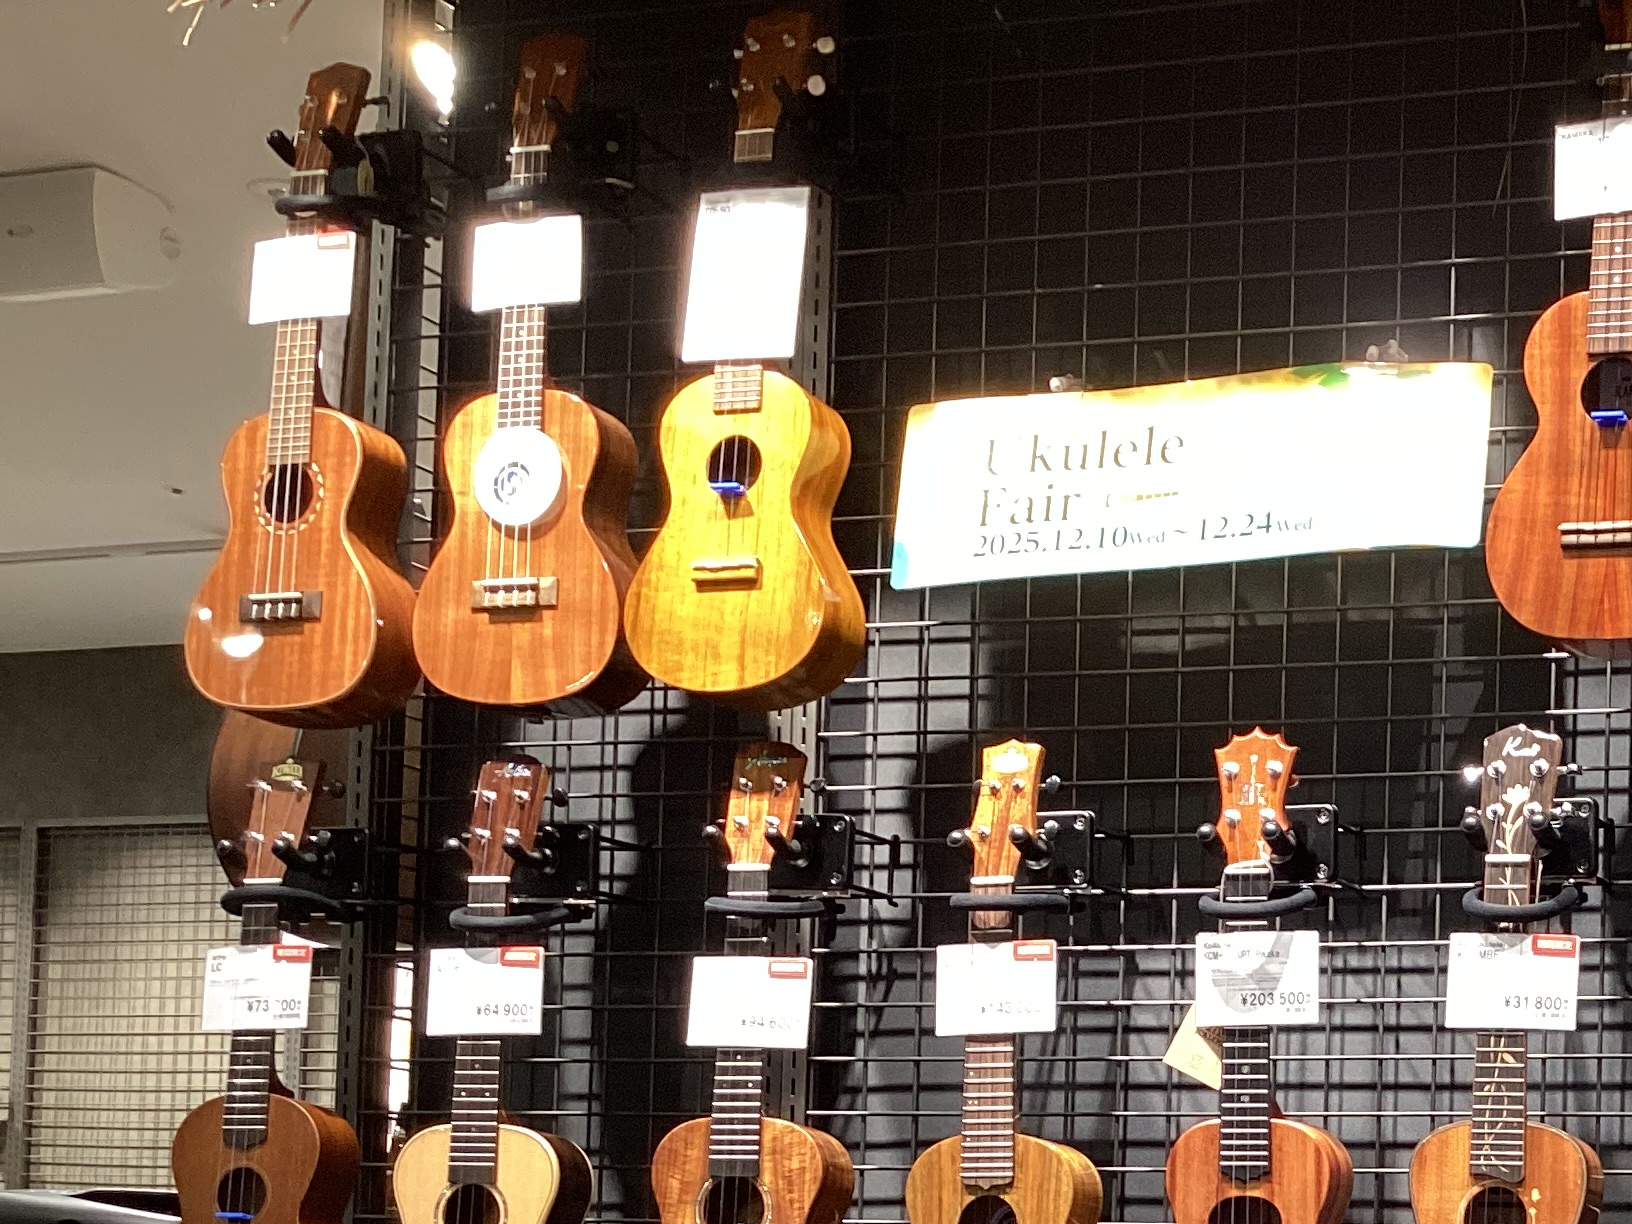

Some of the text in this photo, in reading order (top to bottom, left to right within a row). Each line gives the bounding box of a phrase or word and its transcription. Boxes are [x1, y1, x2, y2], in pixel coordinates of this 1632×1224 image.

[980, 484, 1081, 527] Fair
[1240, 991, 1305, 1007] ¥203500
[1504, 995, 1562, 1011] ¥31800
[476, 1003, 528, 1017] ¥64900
